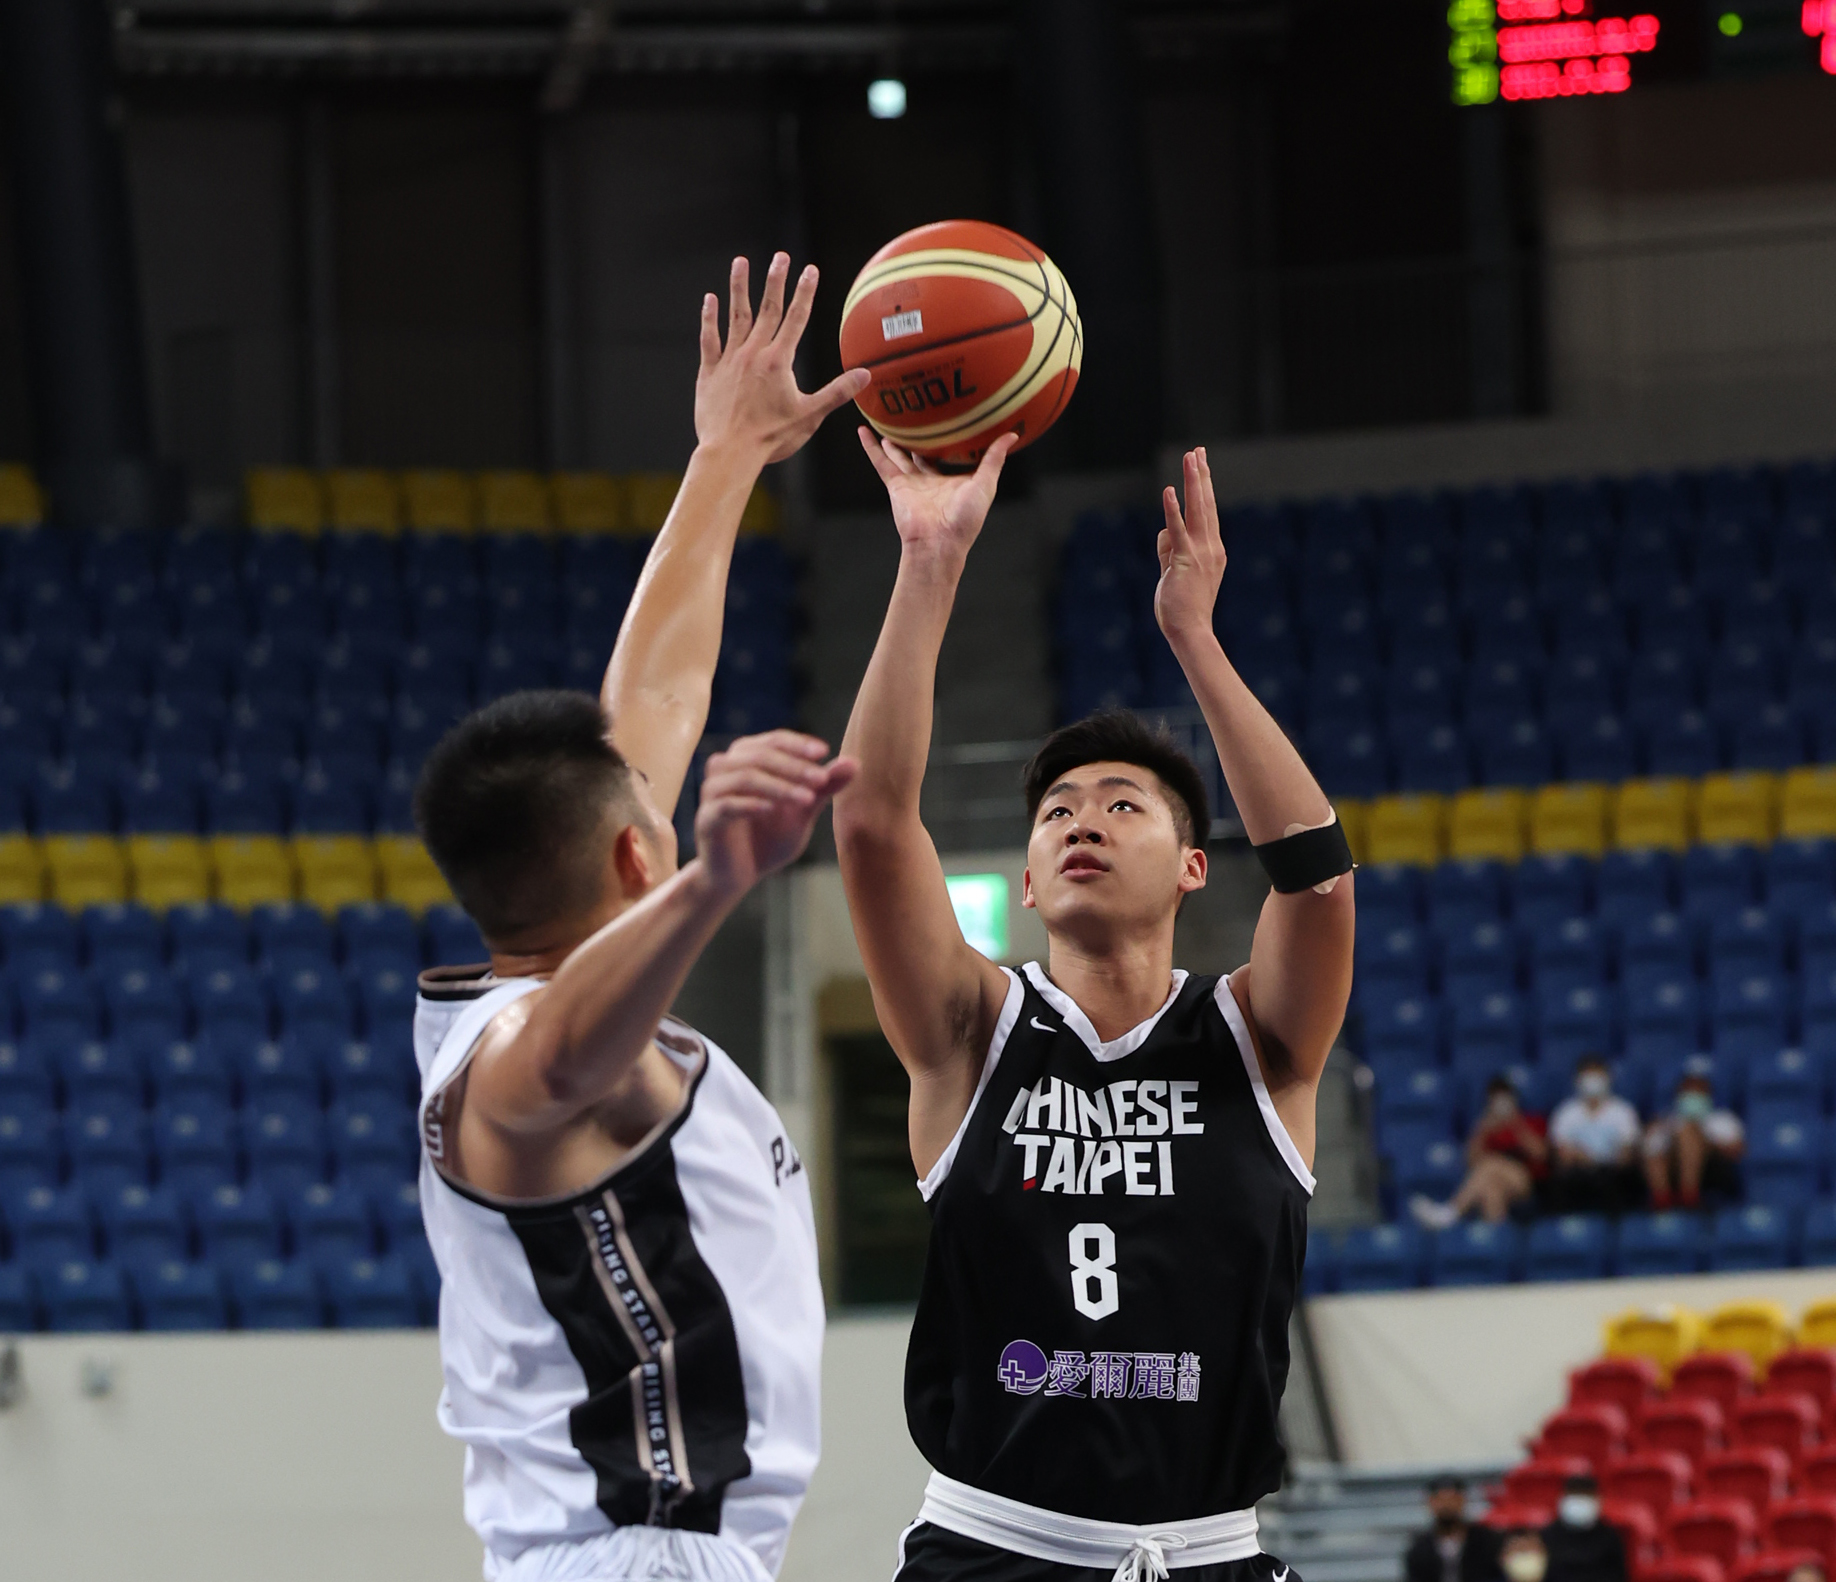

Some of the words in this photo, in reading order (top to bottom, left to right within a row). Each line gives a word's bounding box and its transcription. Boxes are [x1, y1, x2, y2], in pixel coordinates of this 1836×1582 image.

[878, 367, 977, 416] 7000
[1013, 1134, 1175, 1196] TAIPEI
[1068, 1222, 1119, 1321] 8
